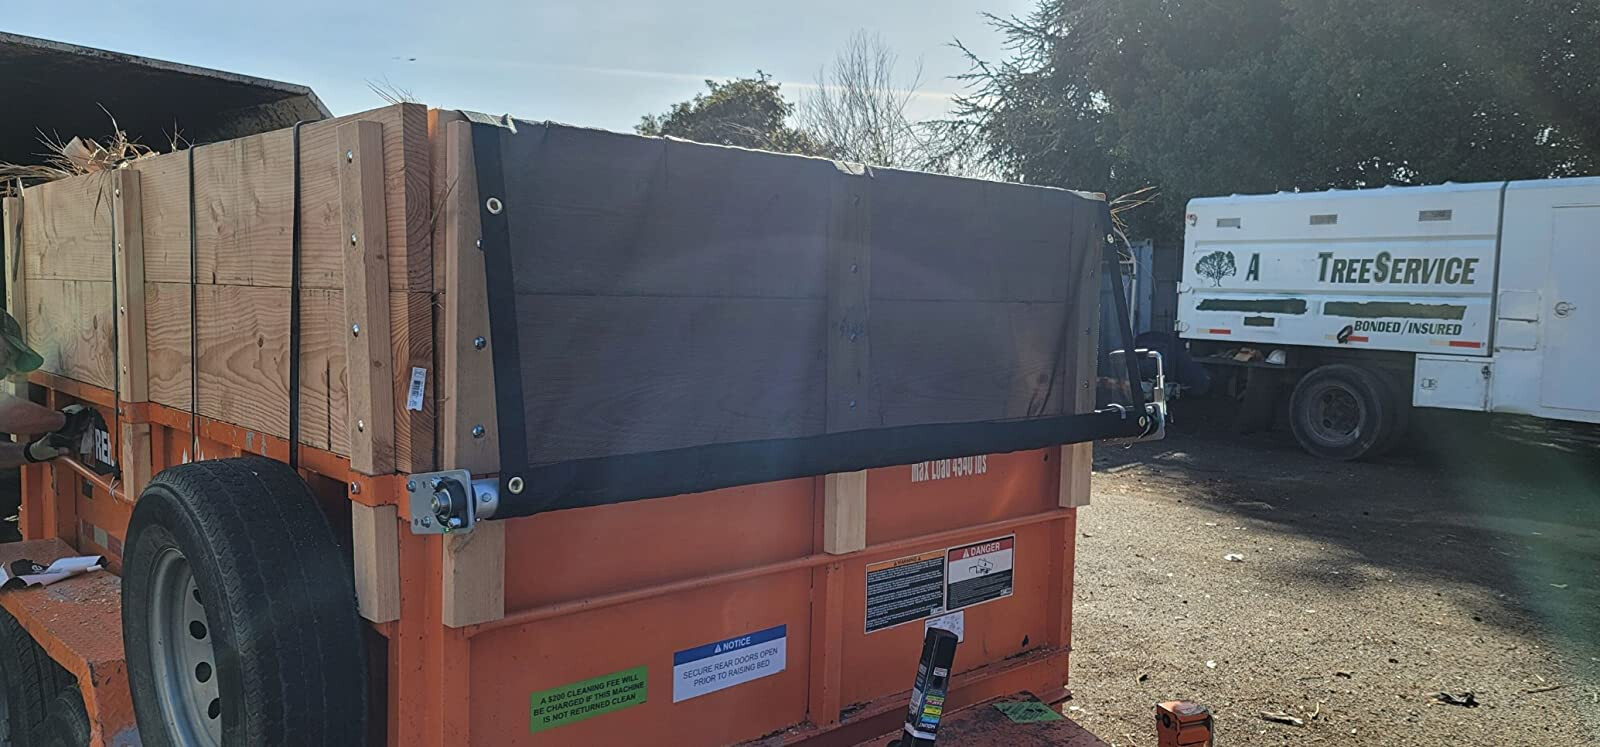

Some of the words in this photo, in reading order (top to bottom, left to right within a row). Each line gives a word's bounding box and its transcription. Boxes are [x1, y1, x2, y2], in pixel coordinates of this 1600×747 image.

[1246, 253, 1260, 281] A
[971, 542, 1001, 556] DANGER
[723, 636, 752, 651] NOTICE
[683, 664, 713, 680] SECURE
[714, 659, 733, 672] REAR
[734, 652, 759, 665] DOORS
[759, 647, 779, 659] OPEN
[693, 674, 717, 687] PRIOR
[718, 671, 727, 680] TO
[728, 665, 756, 677] RAISING
[757, 659, 770, 670] BED
[533, 707, 545, 717] BE
[546, 697, 585, 713] CHARGED
[586, 694, 594, 703] IF
[594, 690, 612, 701] THIS
[612, 681, 645, 696] MACHINE
[540, 697, 547, 705] A
[548, 692, 566, 703] $200
[566, 682, 605, 698] CLEANING
[606, 678, 621, 688] FEE
[622, 674, 639, 684] WILL
[542, 714, 551, 724] IS
[552, 710, 569, 721] NOT
[570, 700, 611, 716] RETURNED
[611, 692, 636, 705] CLEAN
